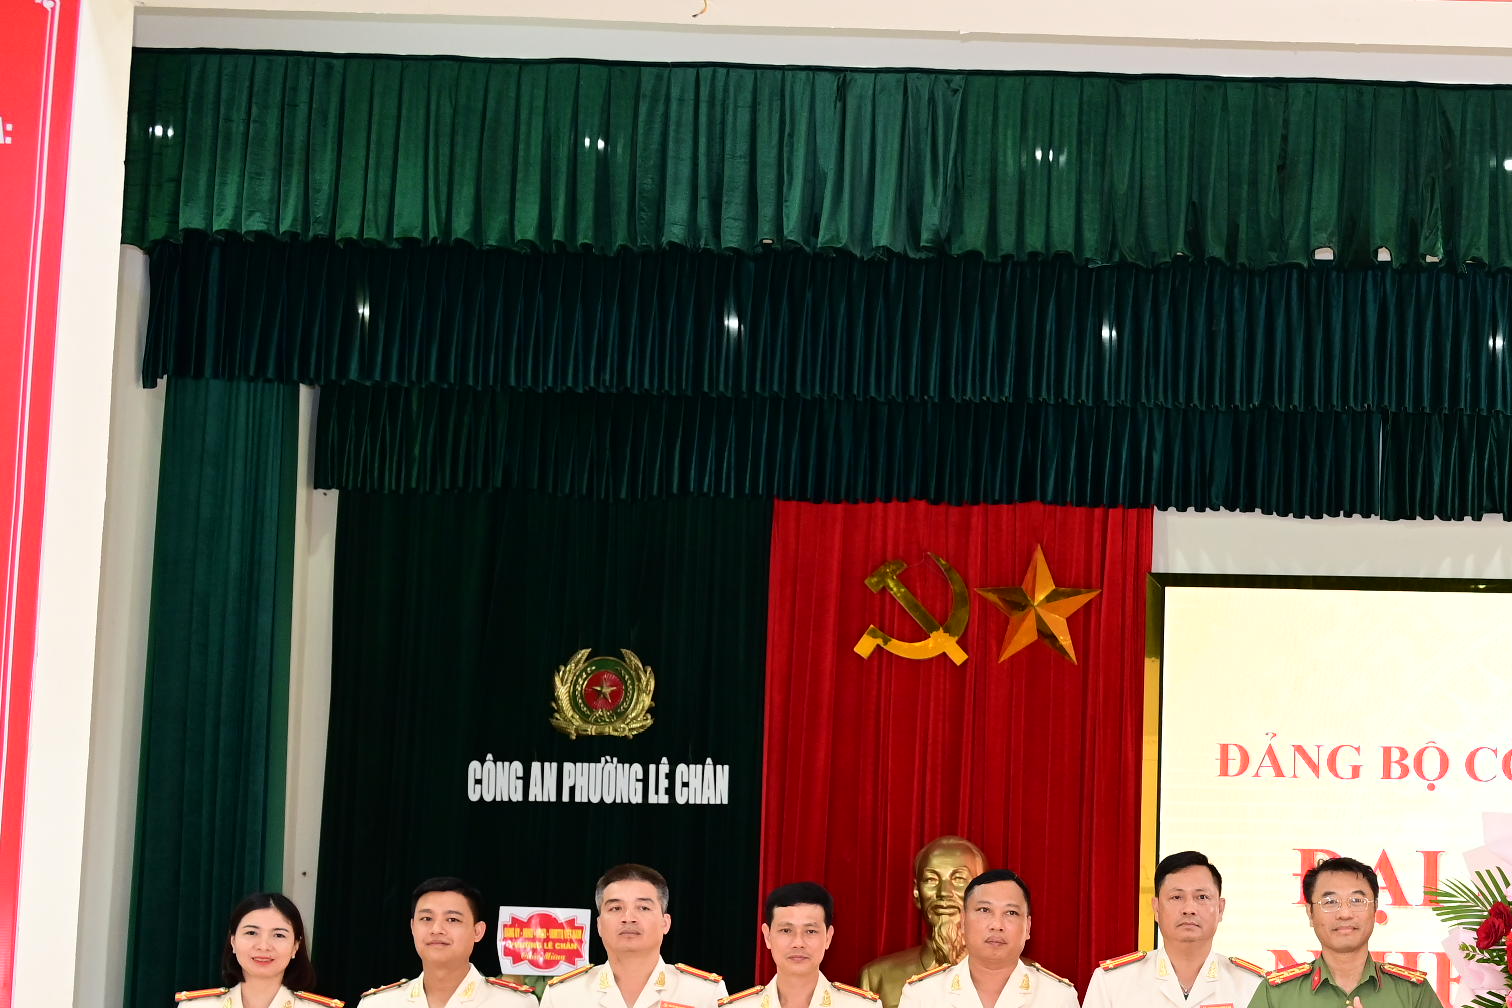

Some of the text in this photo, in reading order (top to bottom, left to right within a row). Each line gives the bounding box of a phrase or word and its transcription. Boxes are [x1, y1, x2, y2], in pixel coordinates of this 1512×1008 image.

[468, 753, 730, 805] CÔNG AN PHƯỜNG LÊ CHÂN
[1216, 732, 1363, 780] ĐẢNG
[1380, 741, 1450, 792] BỘ
